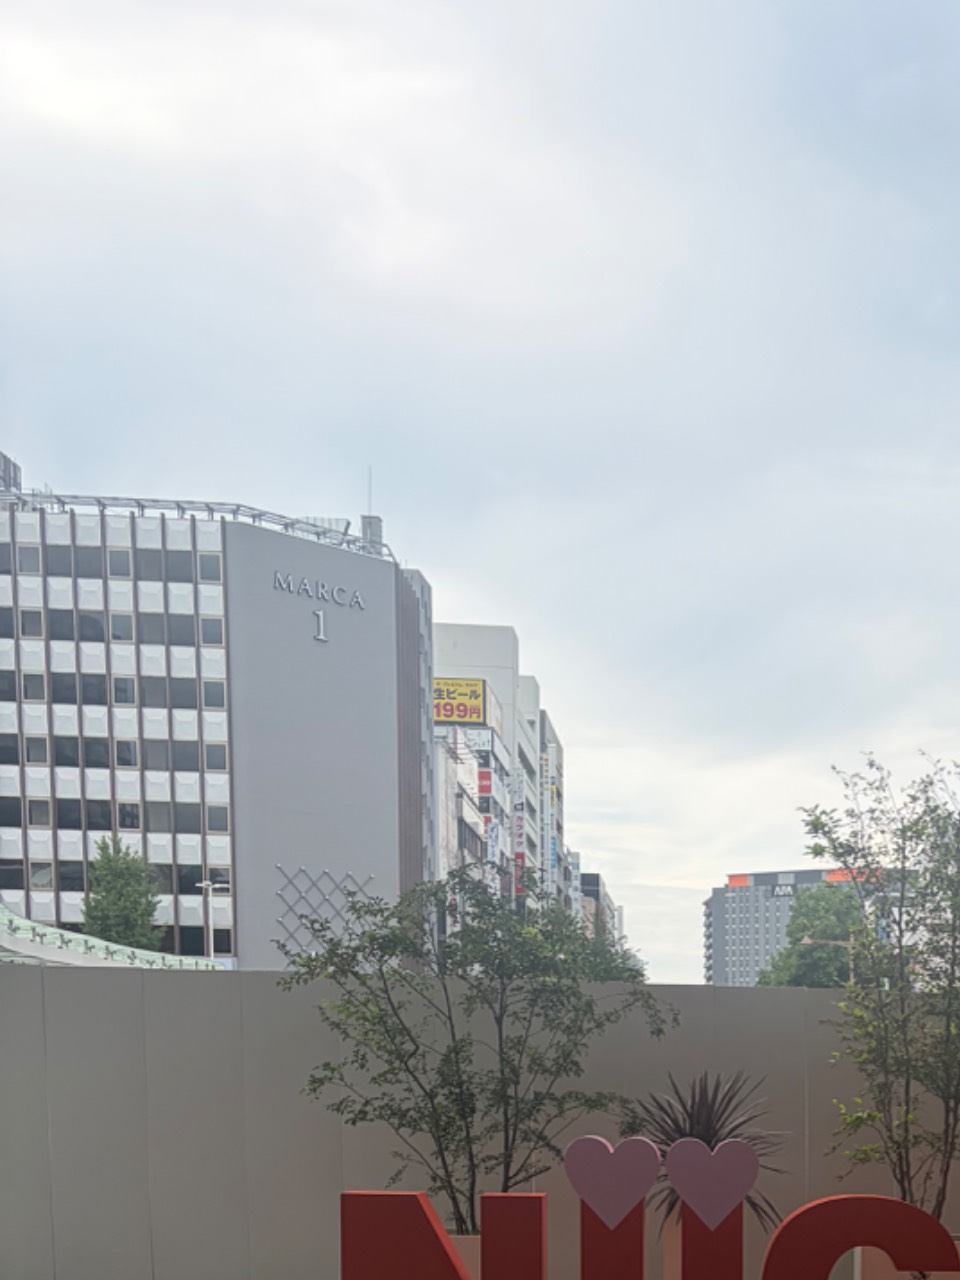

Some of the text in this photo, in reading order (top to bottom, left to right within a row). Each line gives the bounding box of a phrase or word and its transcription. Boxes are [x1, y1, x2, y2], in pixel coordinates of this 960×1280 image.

[273, 570, 365, 610] MARCA
[312, 610, 329, 642] 1
[433, 688, 481, 700] 生ビール
[433, 702, 481, 719] 199円
